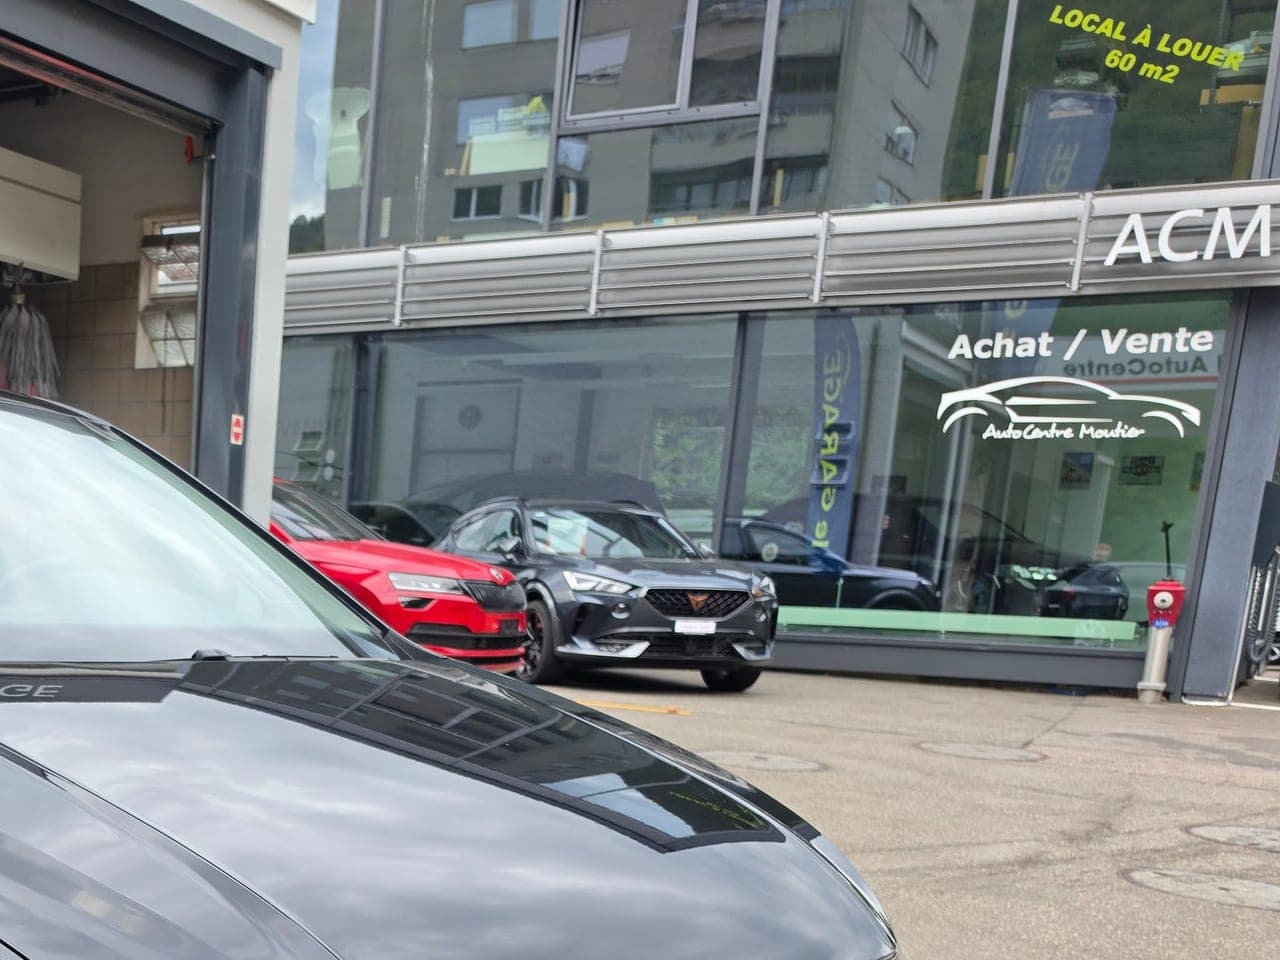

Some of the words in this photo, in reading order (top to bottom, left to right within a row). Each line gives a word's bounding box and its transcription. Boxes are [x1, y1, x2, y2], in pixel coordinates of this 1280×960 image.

[1049, 4, 1127, 41] LOCAL
[1132, 24, 1152, 47] À
[1156, 33, 1245, 72] LOUER
[1104, 49, 1137, 72] 60
[1138, 61, 1180, 84] m2
[1103, 204, 1271, 267] ACM
[947, 331, 1054, 360] Achat
[1063, 328, 1088, 361] /
[1100, 326, 1214, 355] Vente
[981, 422, 1074, 441] AutoCentre
[1078, 421, 1146, 440] Moutier
